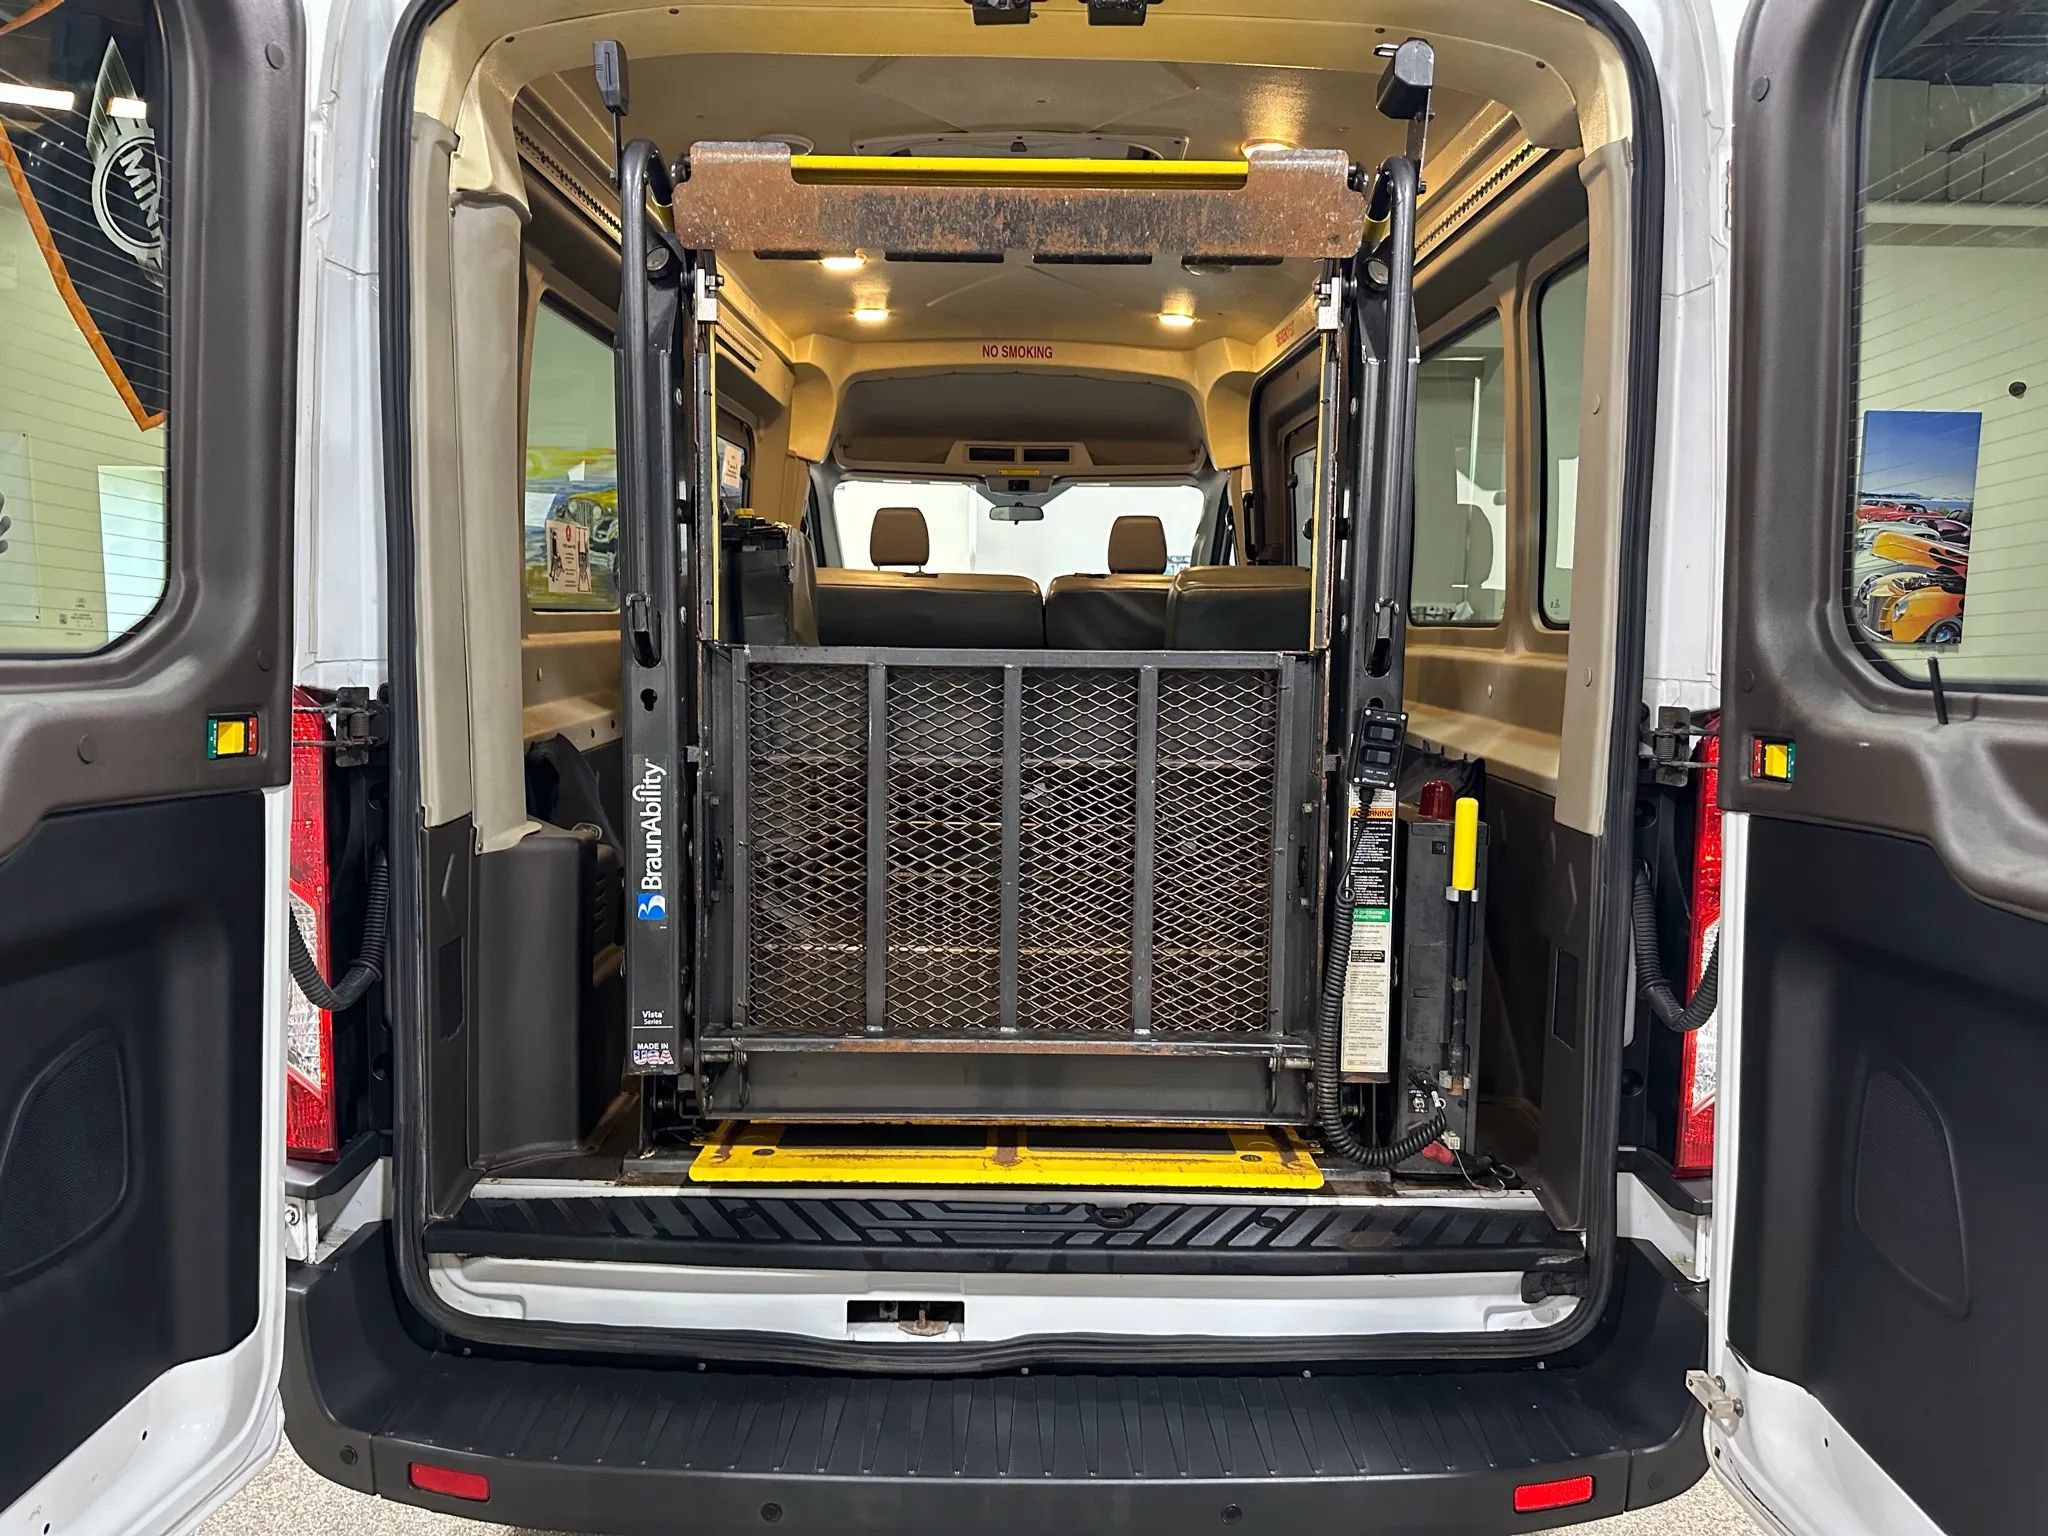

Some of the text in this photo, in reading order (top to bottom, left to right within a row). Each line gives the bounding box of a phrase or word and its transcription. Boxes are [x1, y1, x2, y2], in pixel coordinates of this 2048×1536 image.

[982, 344, 1053, 359] NO SMOKING
[632, 758, 667, 890] BraunAbility
[642, 1010, 665, 1018] Vista
[637, 1042, 669, 1050] MADE IN
[633, 1050, 674, 1065] USA
